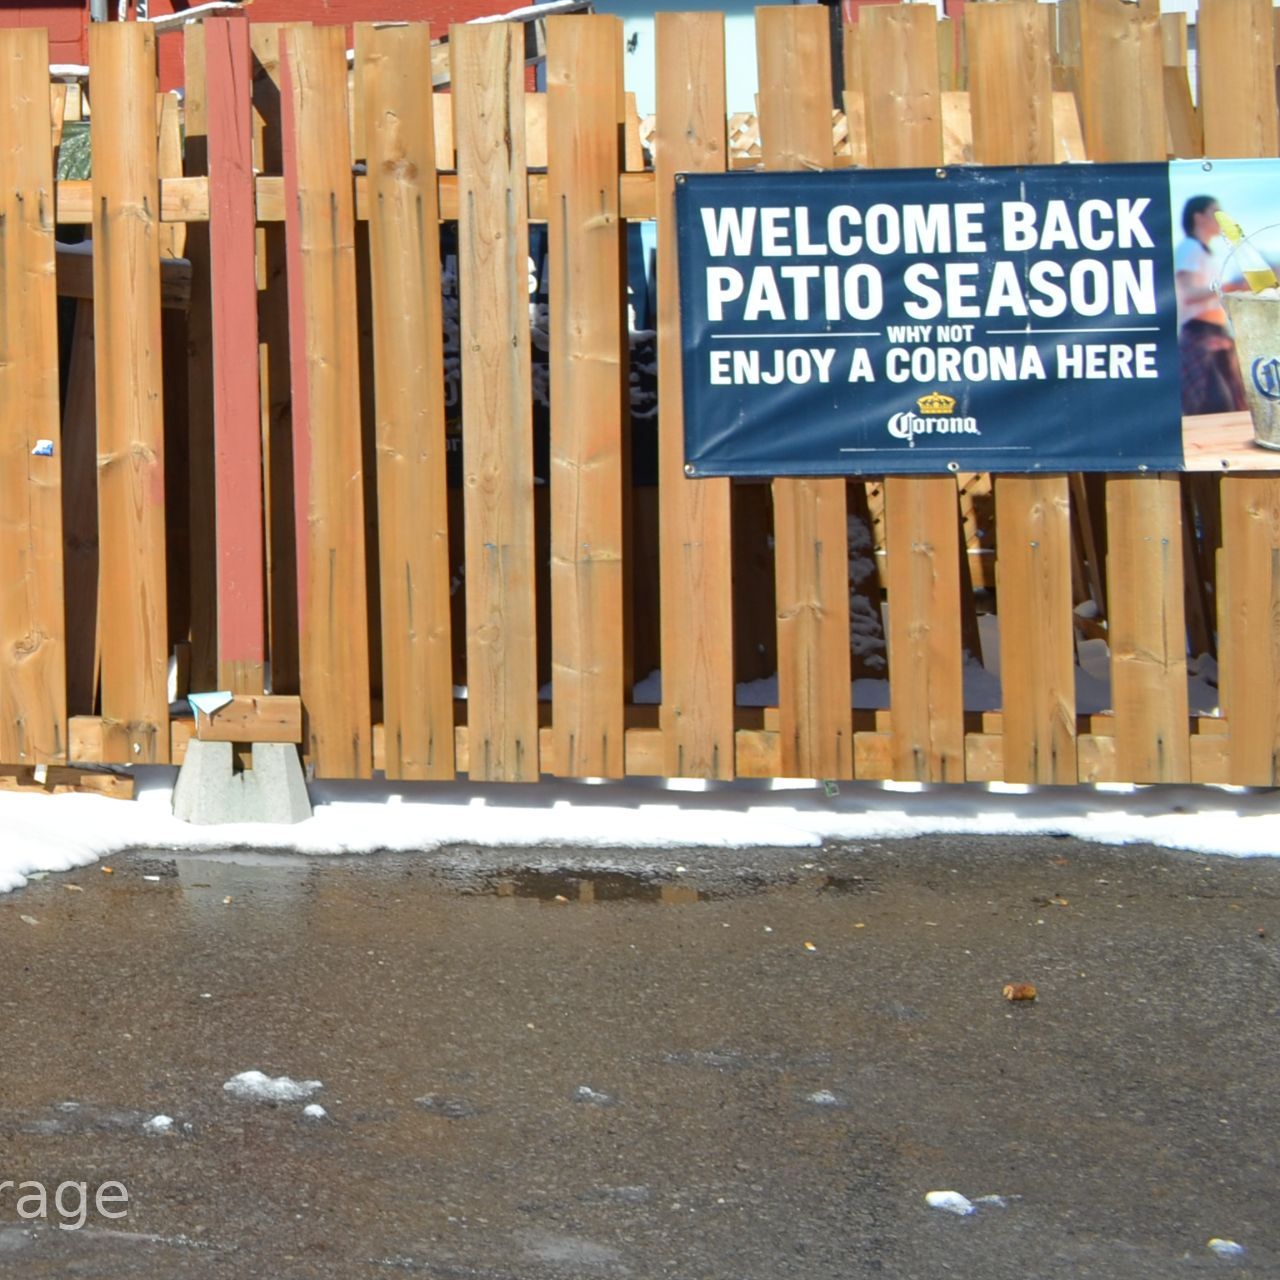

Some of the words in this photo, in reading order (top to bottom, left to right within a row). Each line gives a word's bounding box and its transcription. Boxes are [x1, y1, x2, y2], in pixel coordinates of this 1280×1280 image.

[700, 203, 986, 257] WELCOME
[1002, 198, 1155, 252] BACK
[706, 263, 884, 321] PATIO
[903, 259, 1157, 320] SEASON
[887, 326, 932, 344] WHY
[937, 325, 974, 343] NOT
[710, 348, 836, 385] ENJOY
[848, 348, 875, 383] A
[886, 345, 1046, 383] CORONA
[1056, 343, 1158, 379] HERE
[887, 410, 978, 442] Corona
